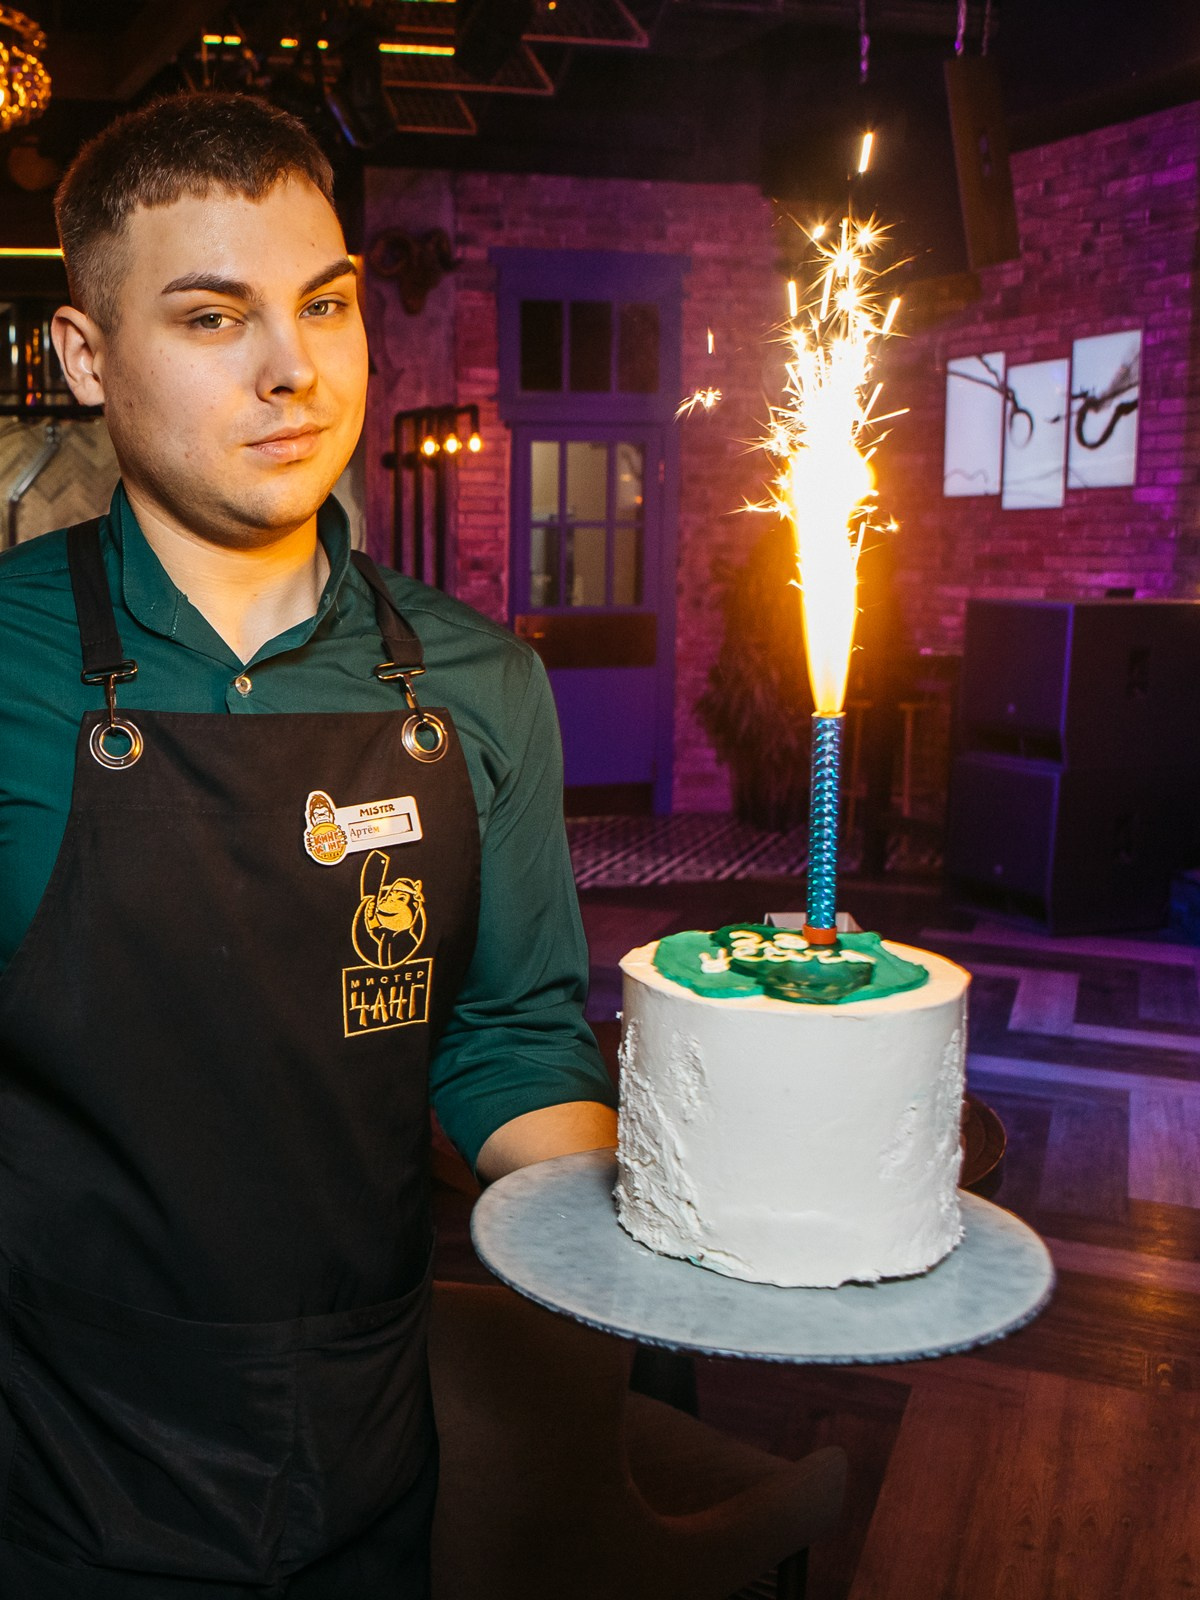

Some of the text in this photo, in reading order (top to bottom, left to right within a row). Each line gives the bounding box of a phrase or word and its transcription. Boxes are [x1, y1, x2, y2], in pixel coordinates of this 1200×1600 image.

[359, 803, 396, 817] MISTER
[349, 825, 380, 839] Артём
[351, 970, 425, 988] МИСТЕР
